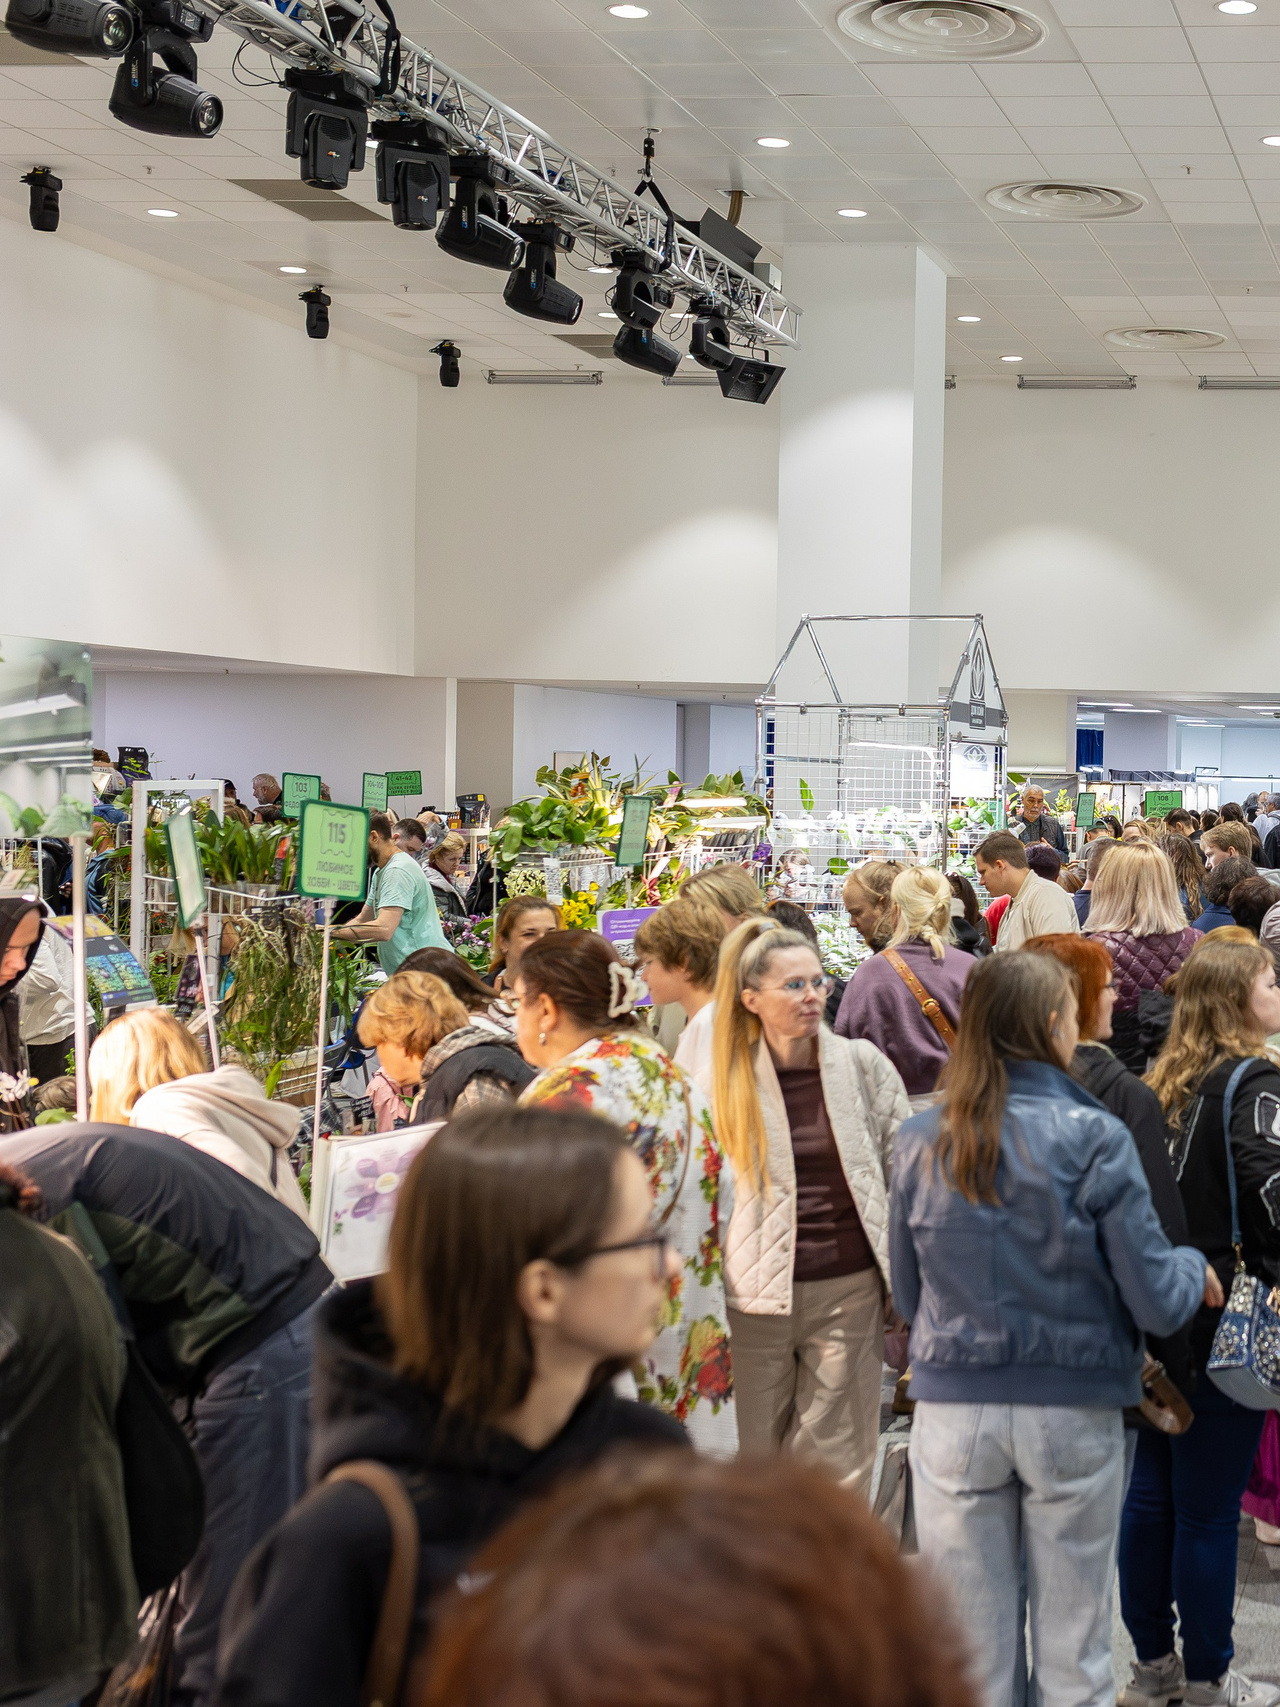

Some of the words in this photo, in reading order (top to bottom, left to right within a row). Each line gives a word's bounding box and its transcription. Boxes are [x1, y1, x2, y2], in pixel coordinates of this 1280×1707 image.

[295, 781, 308, 792] 103
[284, 800, 300, 809] ФЕДО
[328, 822, 347, 844] 115
[316, 860, 354, 876] ЛЮБИМОЕ
